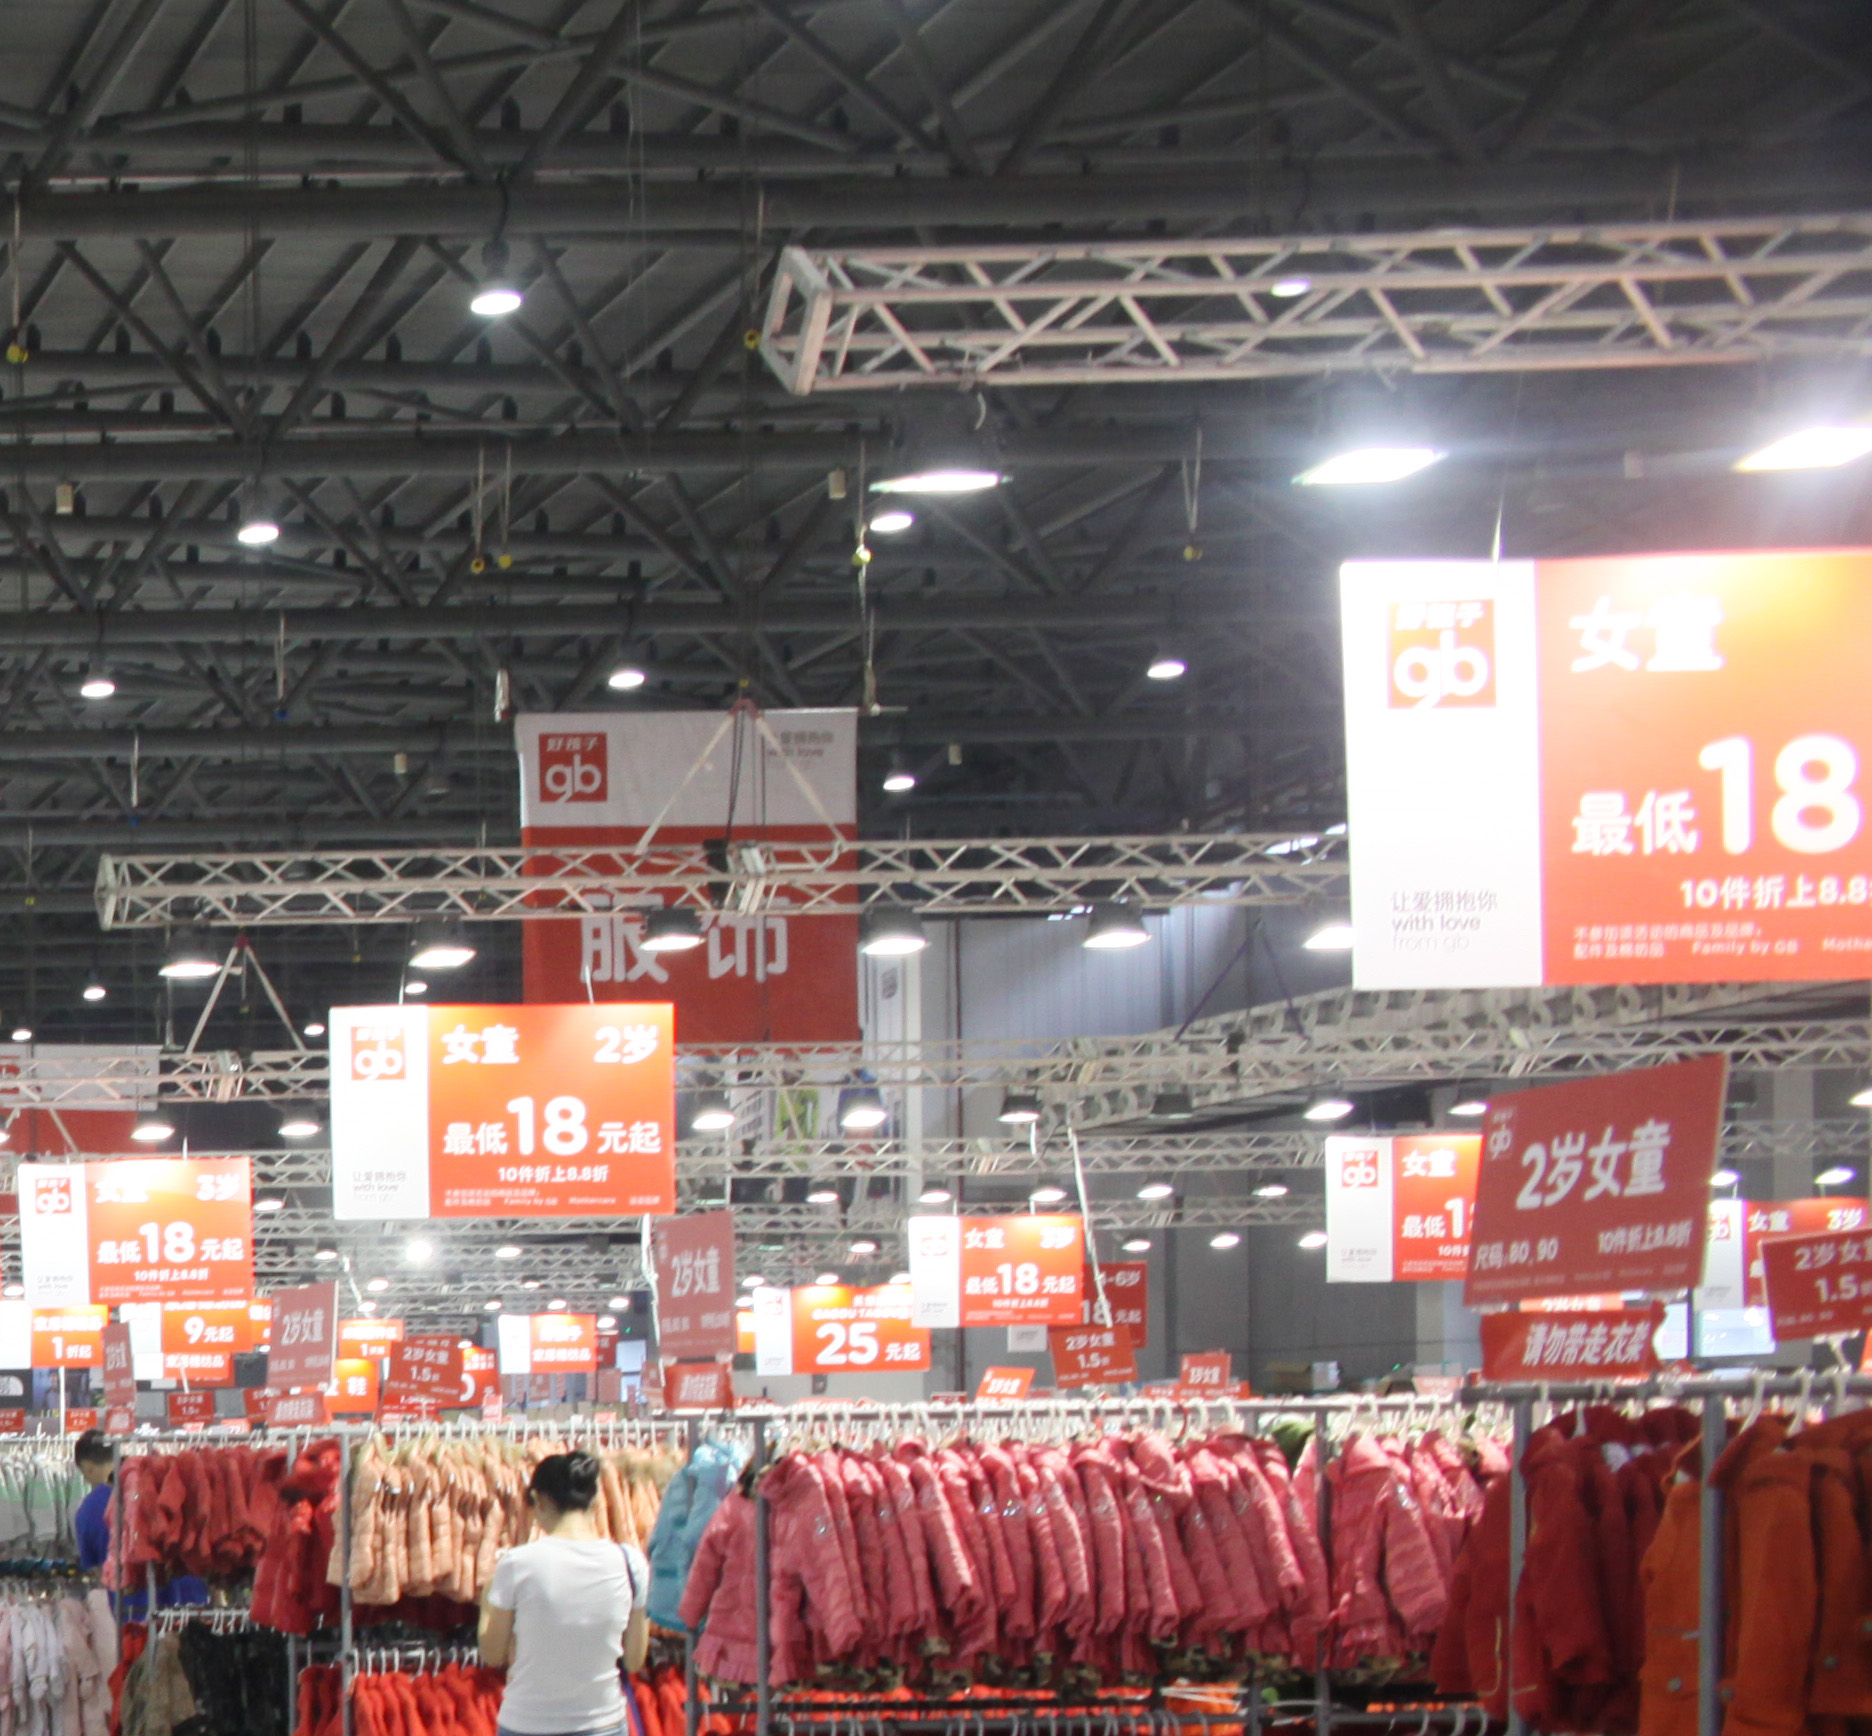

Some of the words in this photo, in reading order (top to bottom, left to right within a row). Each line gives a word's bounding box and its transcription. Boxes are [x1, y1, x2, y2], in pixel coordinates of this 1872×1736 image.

[1569, 595, 1725, 673] 女童
[1393, 630, 1489, 709] gb
[547, 737, 598, 752] 好孩子
[545, 753, 602, 802] gb
[1570, 732, 1862, 857] 最低18
[1391, 889, 1498, 914] 让爱拥抱你
[1680, 875, 1872, 911] 10件折上8.8
[1391, 914, 1434, 931] with
[1440, 914, 1481, 931] love
[1692, 940, 1746, 956] Family
[1750, 940, 1770, 956] by
[354, 1040, 403, 1080] gb
[441, 1024, 520, 1065] 女童
[593, 1024, 659, 1065] 2岁
[443, 1095, 661, 1156] 最低18元起
[498, 1164, 609, 1183] 10件折上8.8折
[1402, 1148, 1456, 1178] 女童
[1515, 1118, 1671, 1212] 2岁女童
[97, 1221, 244, 1264] 最低18元起
[964, 1227, 1005, 1250] 女童
[671, 1246, 722, 1298] 2岁女童
[965, 1262, 1076, 1296] 最低18元起
[815, 1321, 921, 1366] 25元起
[1522, 1318, 1651, 1367] 请勿带走衣架
